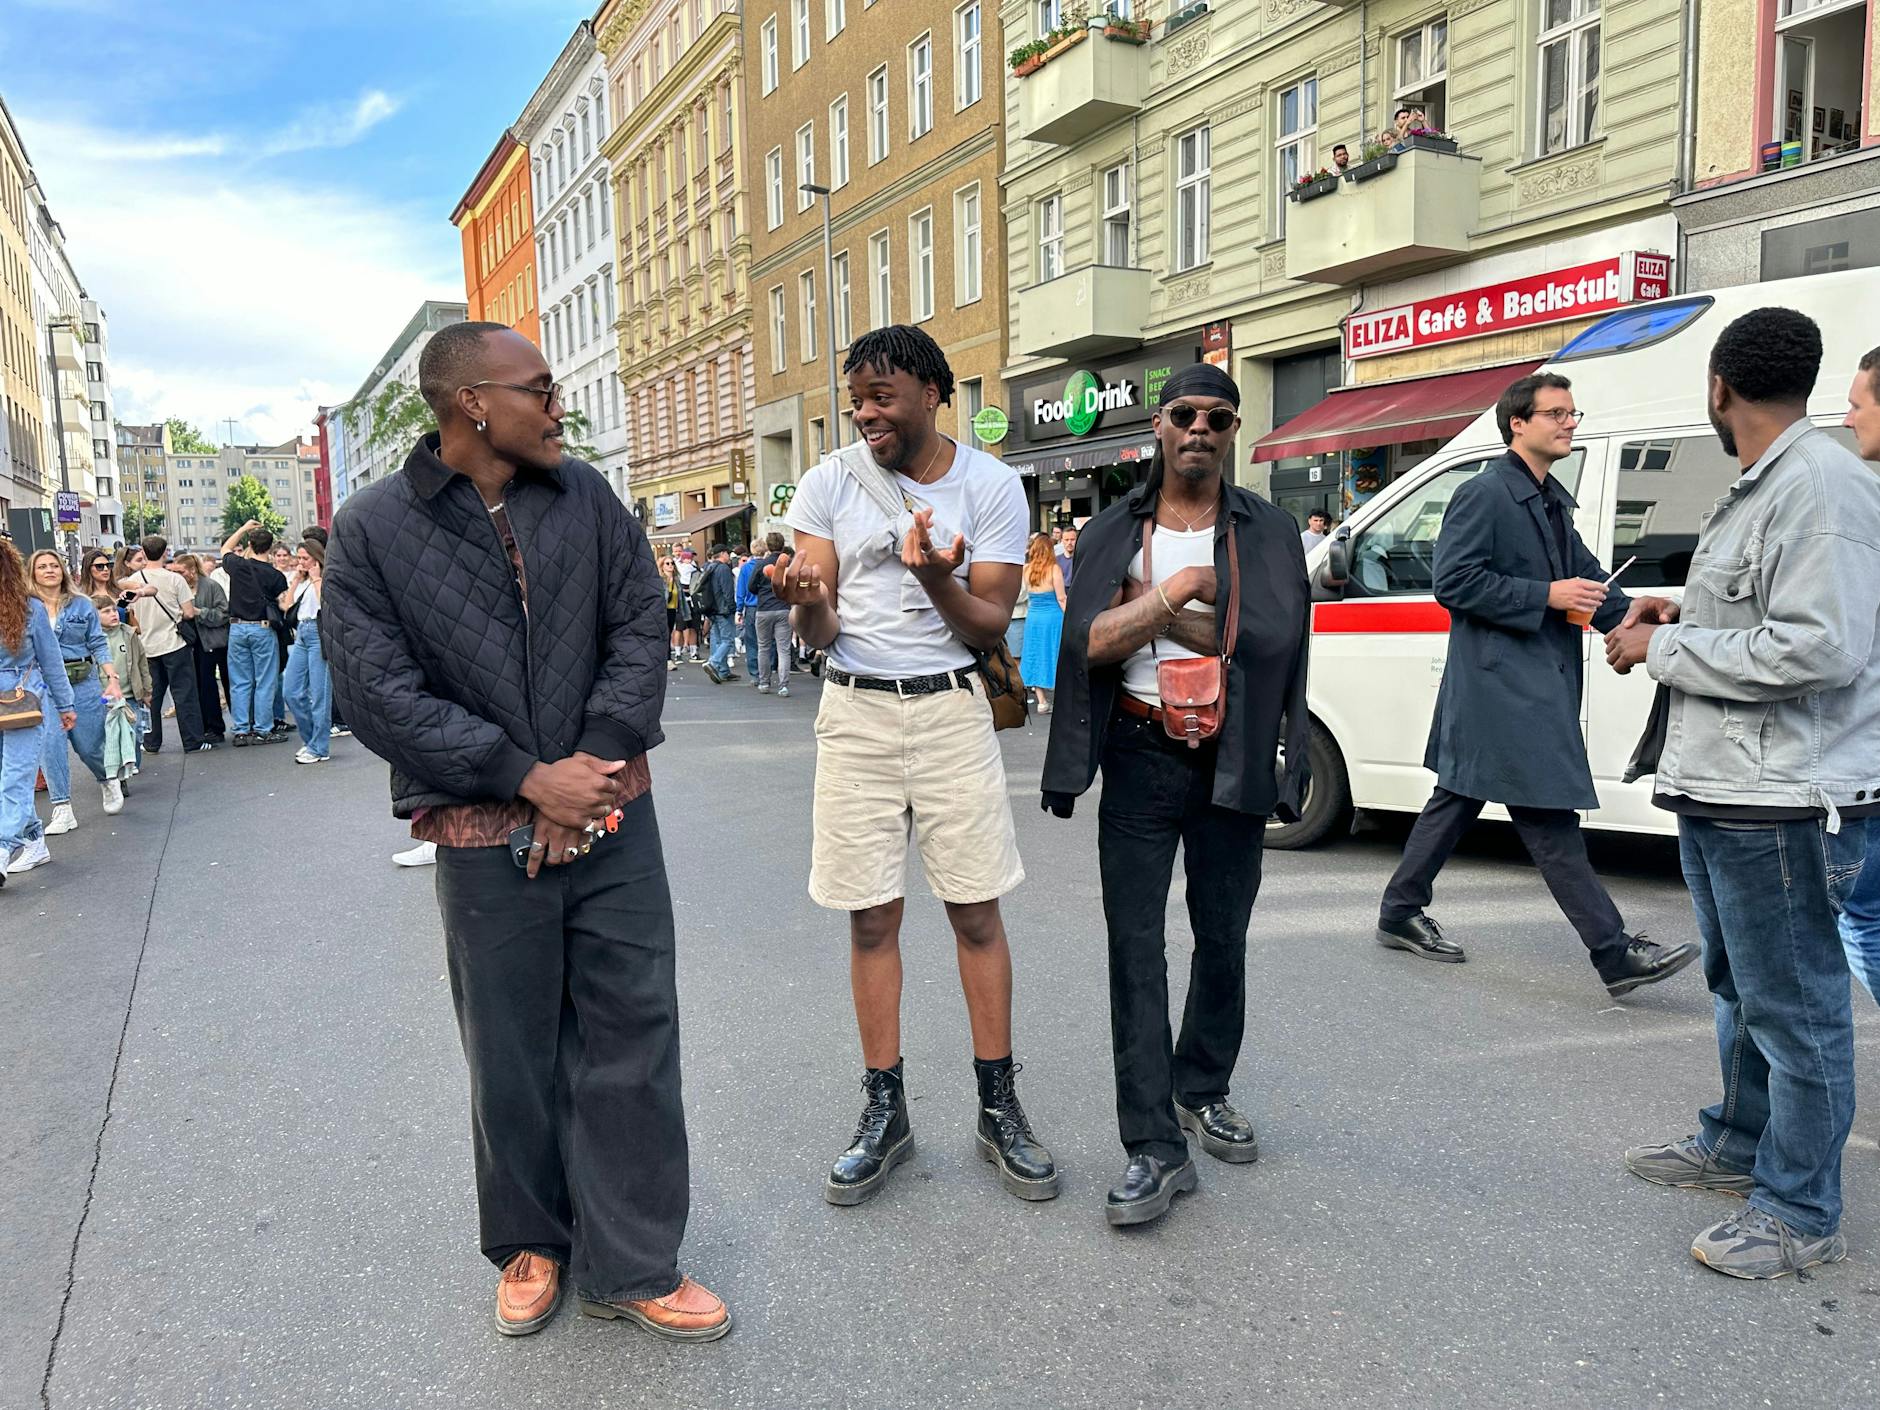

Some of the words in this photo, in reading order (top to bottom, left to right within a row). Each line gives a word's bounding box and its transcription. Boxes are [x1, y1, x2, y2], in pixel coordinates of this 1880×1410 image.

[1639, 261, 1664, 277] ELIZA
[1640, 282, 1661, 298] Café
[1352, 315, 1409, 348] ELIZA
[1418, 301, 1467, 336] Café
[1475, 297, 1493, 325] &
[1149, 366, 1171, 380] SNACK
[1034, 392, 1074, 425] Food
[1085, 379, 1133, 414] Drink
[1311, 470, 1318, 480] 16
[770, 500, 791, 516] CA
